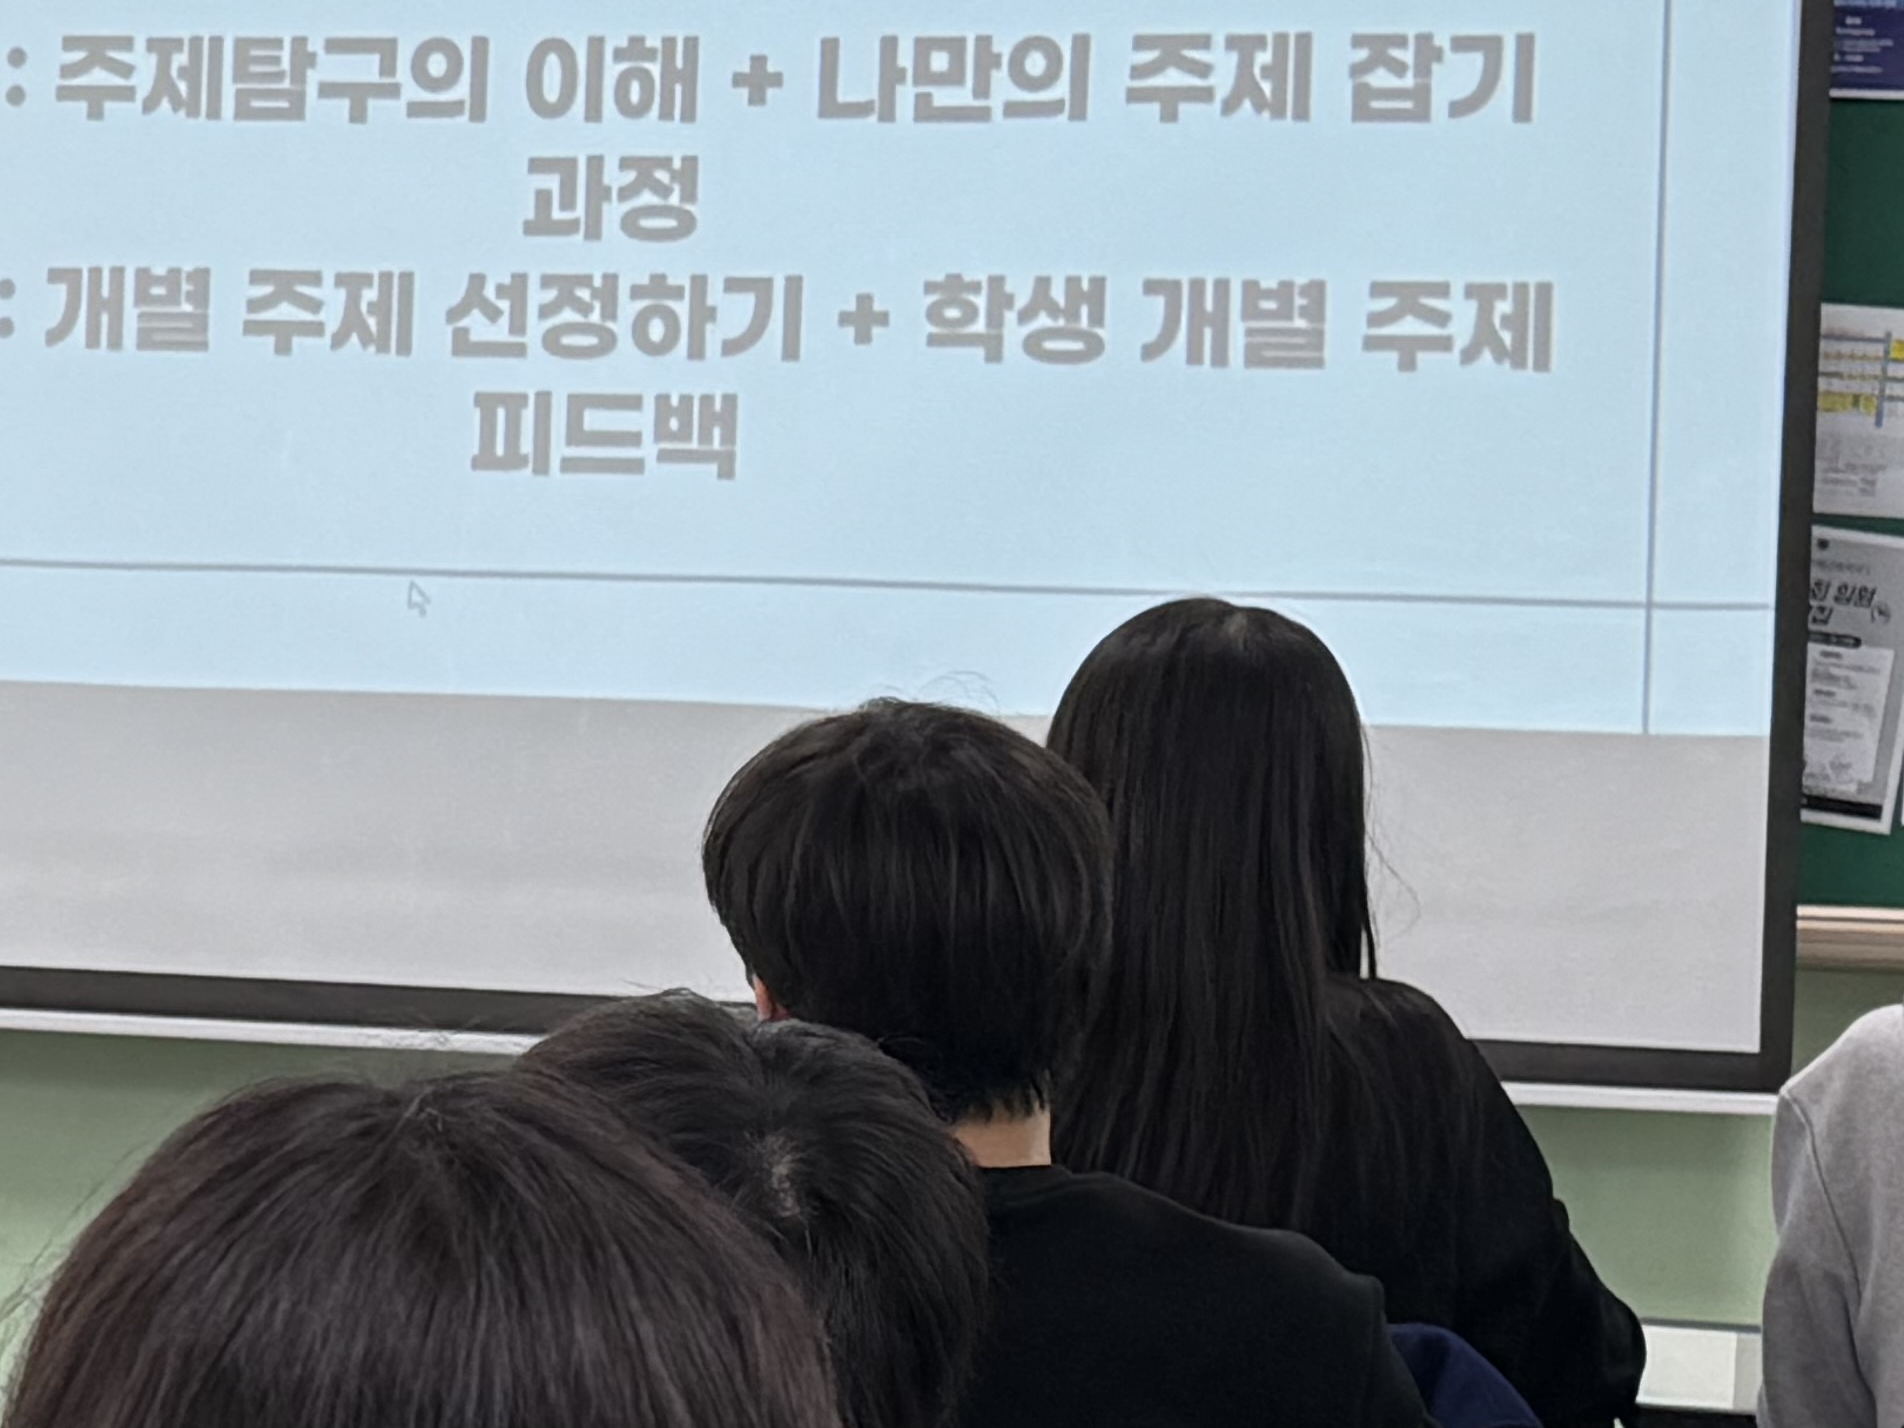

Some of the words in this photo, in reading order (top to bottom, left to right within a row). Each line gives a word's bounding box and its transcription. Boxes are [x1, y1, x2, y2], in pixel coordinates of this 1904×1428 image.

[55, 35, 489, 125] 주제탐구의
[525, 35, 699, 123] 이해
[817, 33, 1091, 123] 나만의
[1125, 32, 1313, 123] 주제
[1349, 32, 1535, 123] 잡기
[523, 154, 699, 242] 과정
[45, 266, 210, 351] 개별
[242, 269, 414, 356] 주제
[445, 272, 803, 362] 선정하기
[924, 273, 1107, 364] 학생
[1141, 278, 1325, 369] 개별
[1362, 281, 1553, 372] 주제
[471, 390, 738, 480] 피드백
